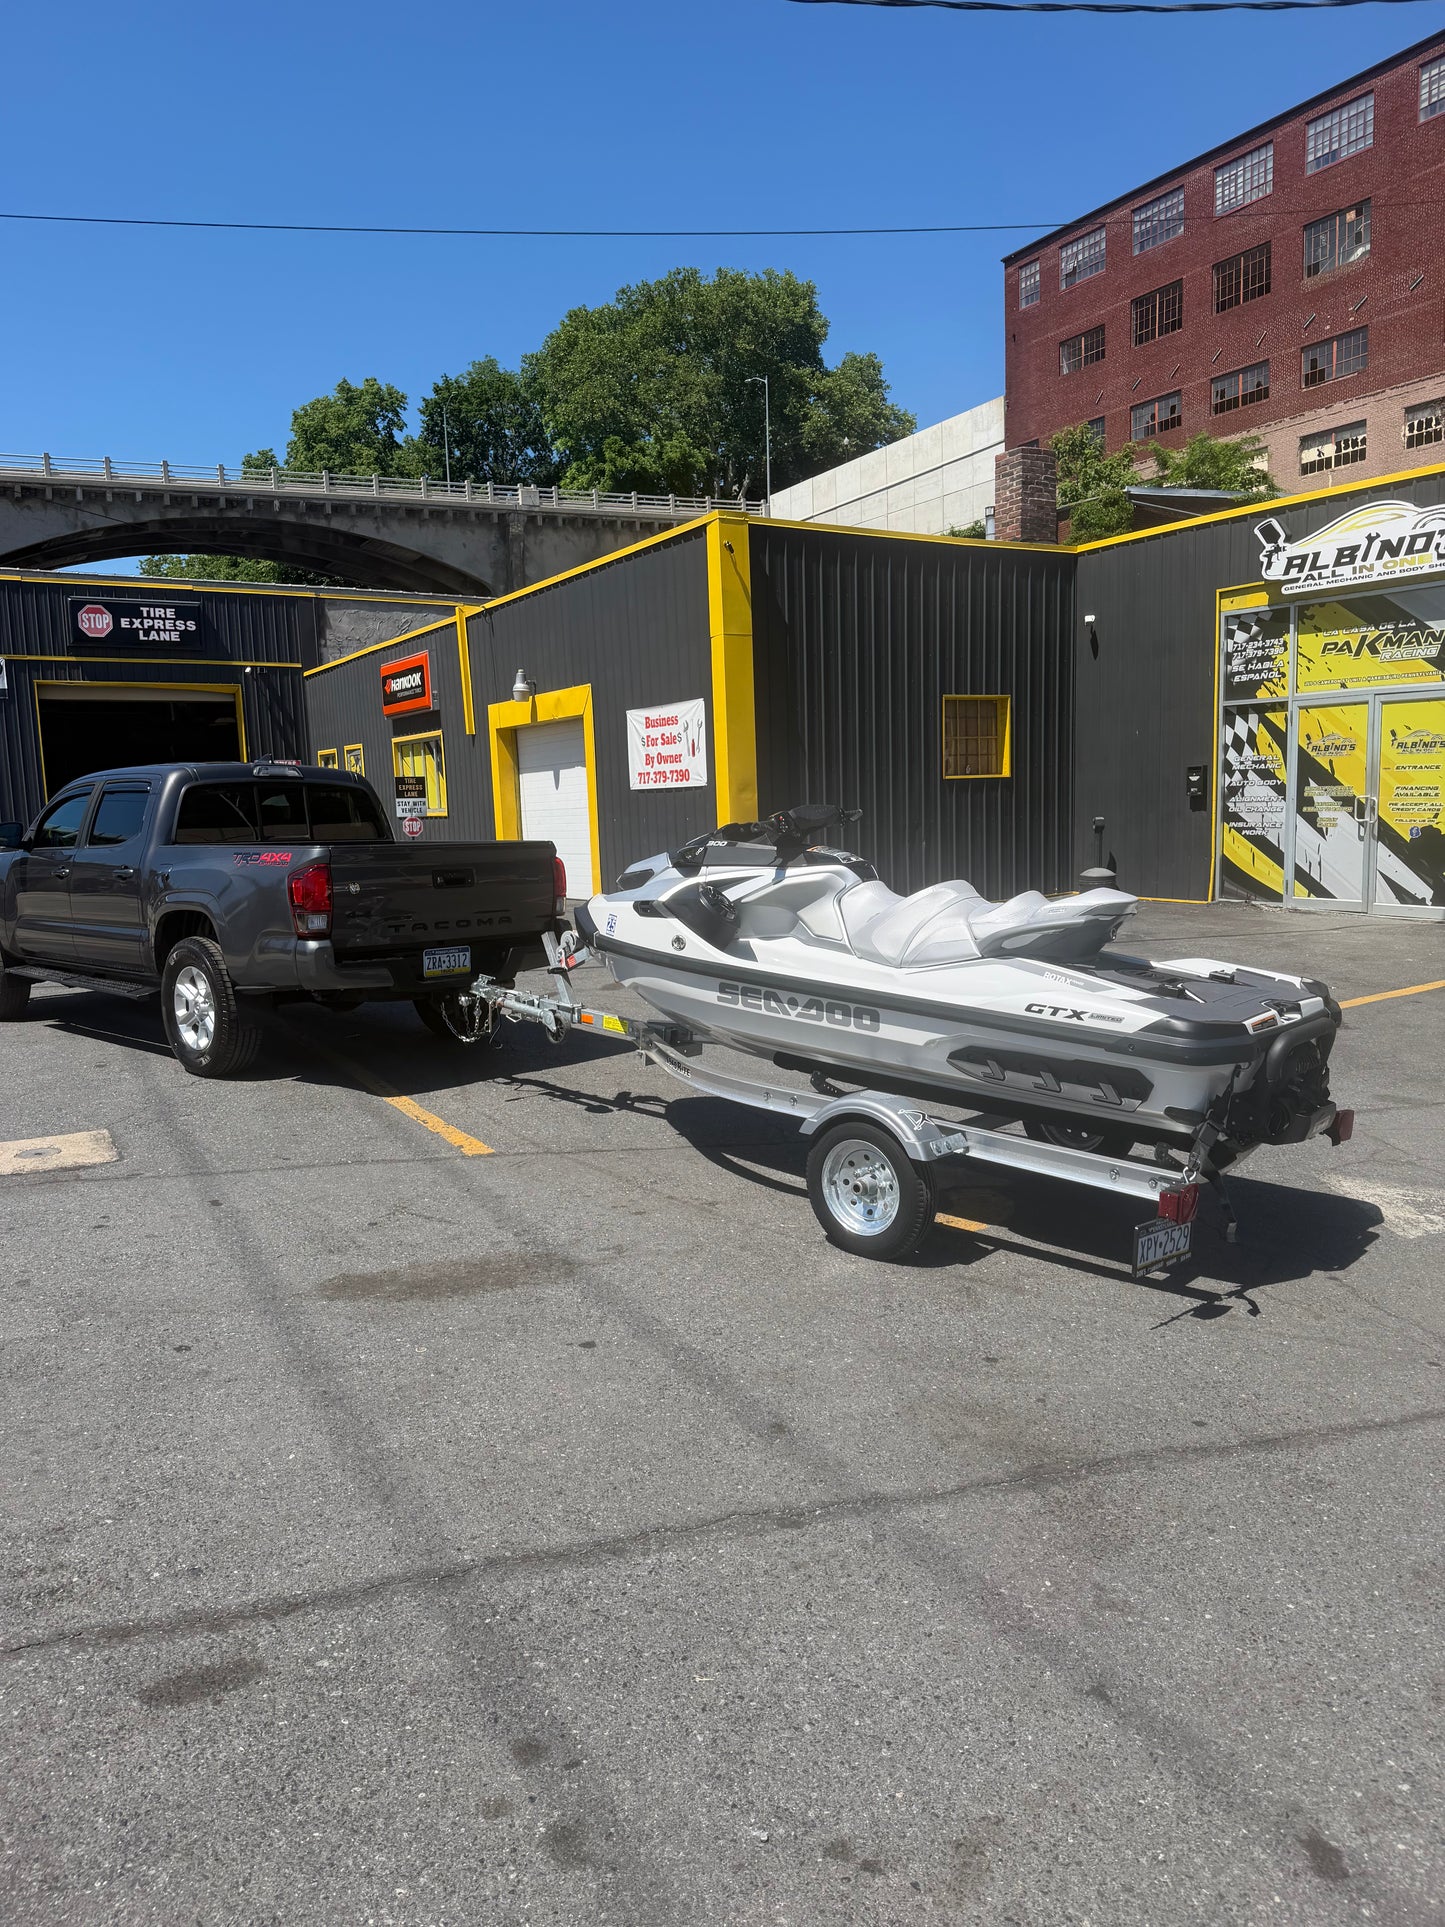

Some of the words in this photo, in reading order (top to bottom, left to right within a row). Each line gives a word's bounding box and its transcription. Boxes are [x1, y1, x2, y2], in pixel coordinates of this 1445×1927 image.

[1302, 570, 1344, 582] ALL
[1352, 564, 1375, 575] IN
[1382, 553, 1433, 570] ONE
[1284, 582, 1323, 592] GENERAL
[1326, 573, 1373, 585] MECHANIC
[1399, 565, 1425, 573] BODY
[140, 607, 176, 618] TIRE
[81, 613, 109, 629] STOP
[120, 618, 197, 631] EXPRESS
[139, 630, 181, 641] LANE
[1343, 625, 1375, 635] CASA
[1379, 622, 1395, 630] DE
[1320, 628, 1445, 659] PAKMAN
[1380, 645, 1440, 662] RACING
[1232, 664, 1246, 672] SE
[1248, 661, 1284, 670] HABLA
[1234, 670, 1282, 682] ESPAÑOL
[644, 715, 679, 729] Business
[1311, 742, 1356, 752] ALBINO'S
[645, 753, 655, 768] By
[656, 752, 682, 765] Owner
[638, 768, 690, 785] 717-379-7390
[405, 821, 421, 832] STOP
[233, 852, 260, 866] TRD
[260, 852, 292, 863] 4X4
[388, 916, 513, 933] TACOMA
[1043, 972, 1072, 985] ROTAX
[1024, 1003, 1089, 1021] GTX
